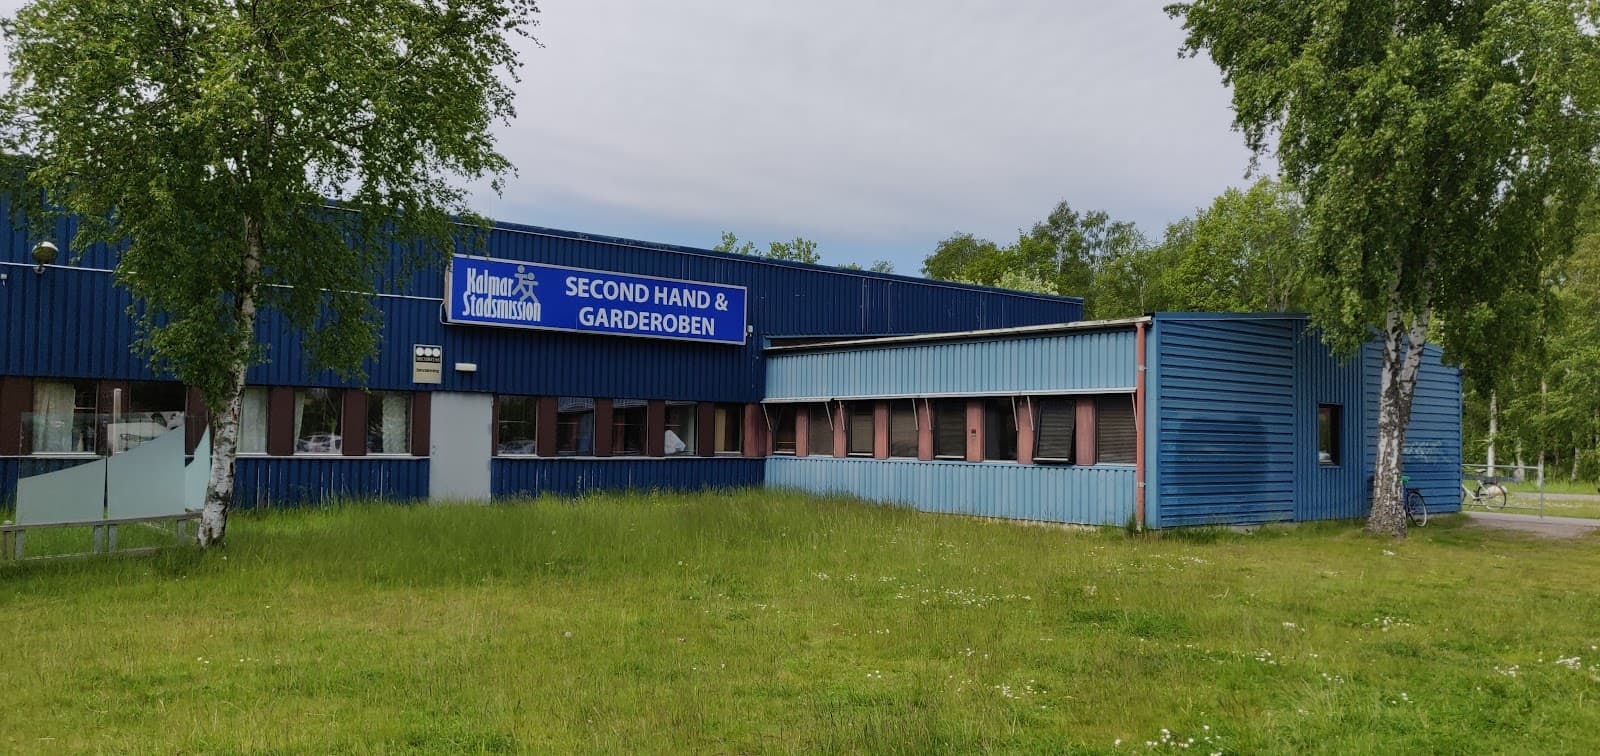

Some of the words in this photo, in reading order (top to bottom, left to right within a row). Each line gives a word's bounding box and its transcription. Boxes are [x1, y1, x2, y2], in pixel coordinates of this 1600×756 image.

[466, 267, 514, 297] Kalmar
[565, 276, 649, 303] SECOND
[655, 286, 711, 309] HAND
[714, 292, 728, 311] &
[462, 291, 541, 322] Stadsmission
[579, 306, 715, 336] GARDEROBEN
